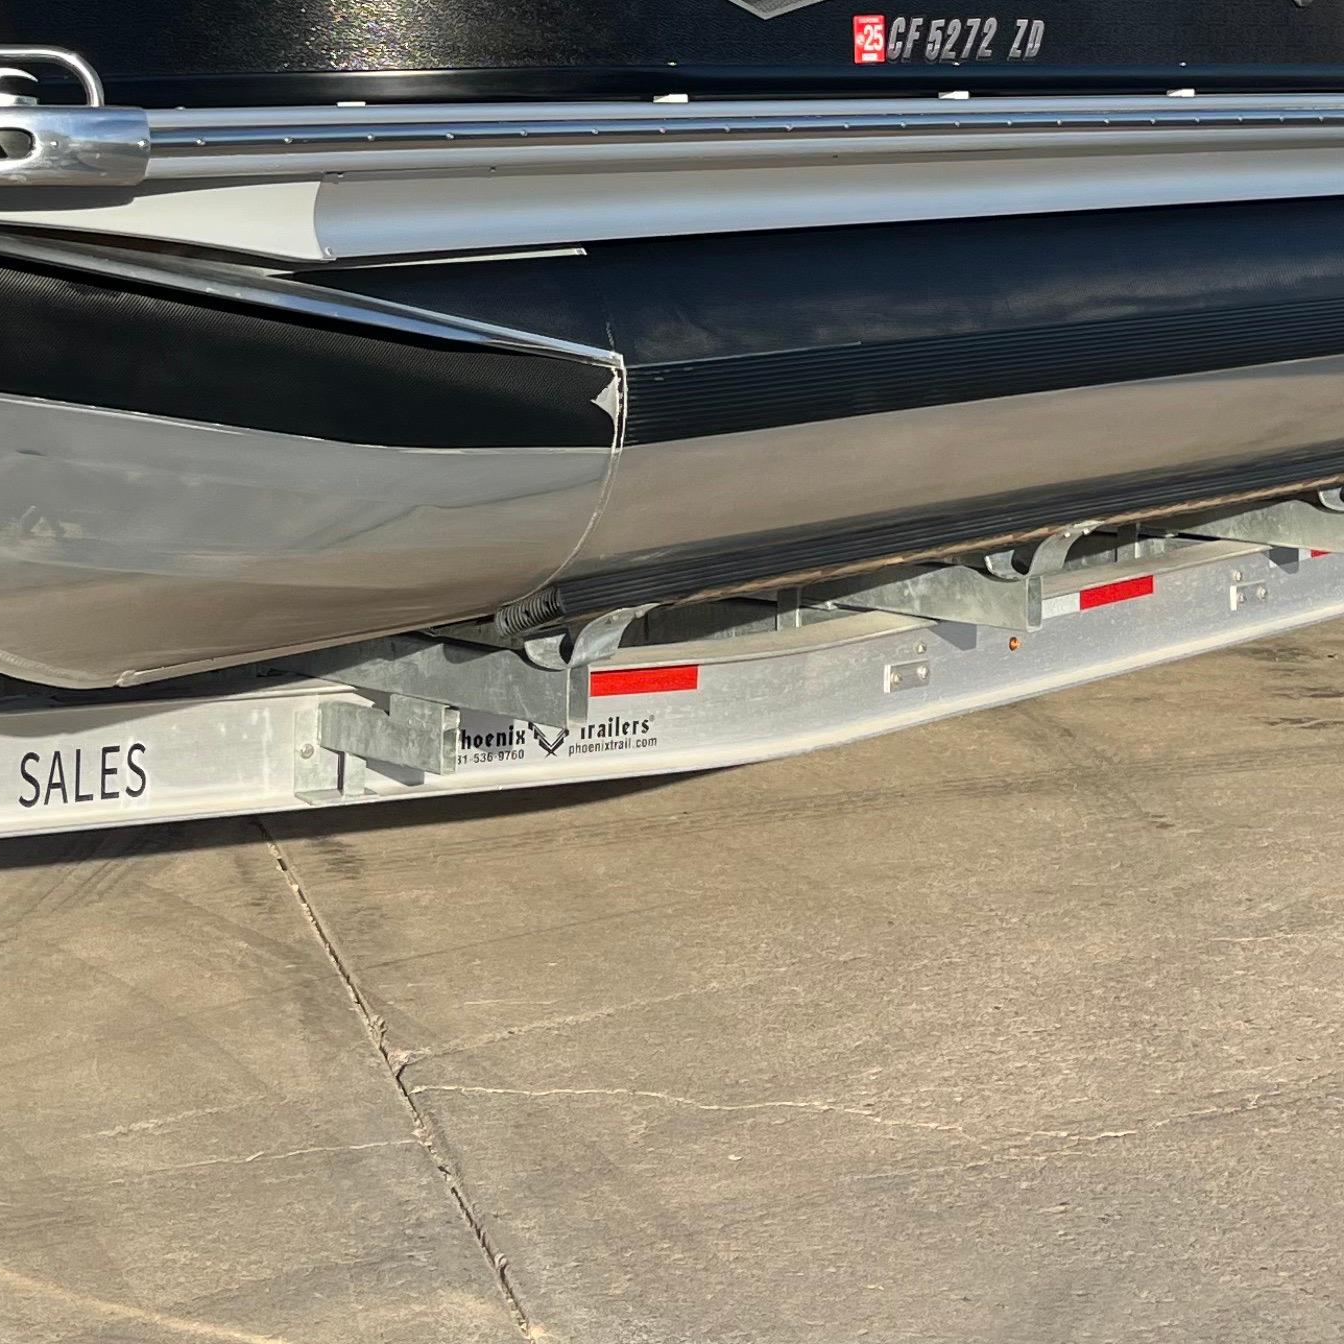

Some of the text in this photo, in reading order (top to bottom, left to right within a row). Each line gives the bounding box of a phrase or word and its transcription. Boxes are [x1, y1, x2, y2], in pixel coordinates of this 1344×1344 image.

[863, 24, 884, 51] 25
[887, 16, 1046, 60] CF 5272 ZD
[460, 724, 526, 750] hoenix
[568, 737, 657, 757] phoenixtrail.com
[17, 742, 148, 808] SALES
